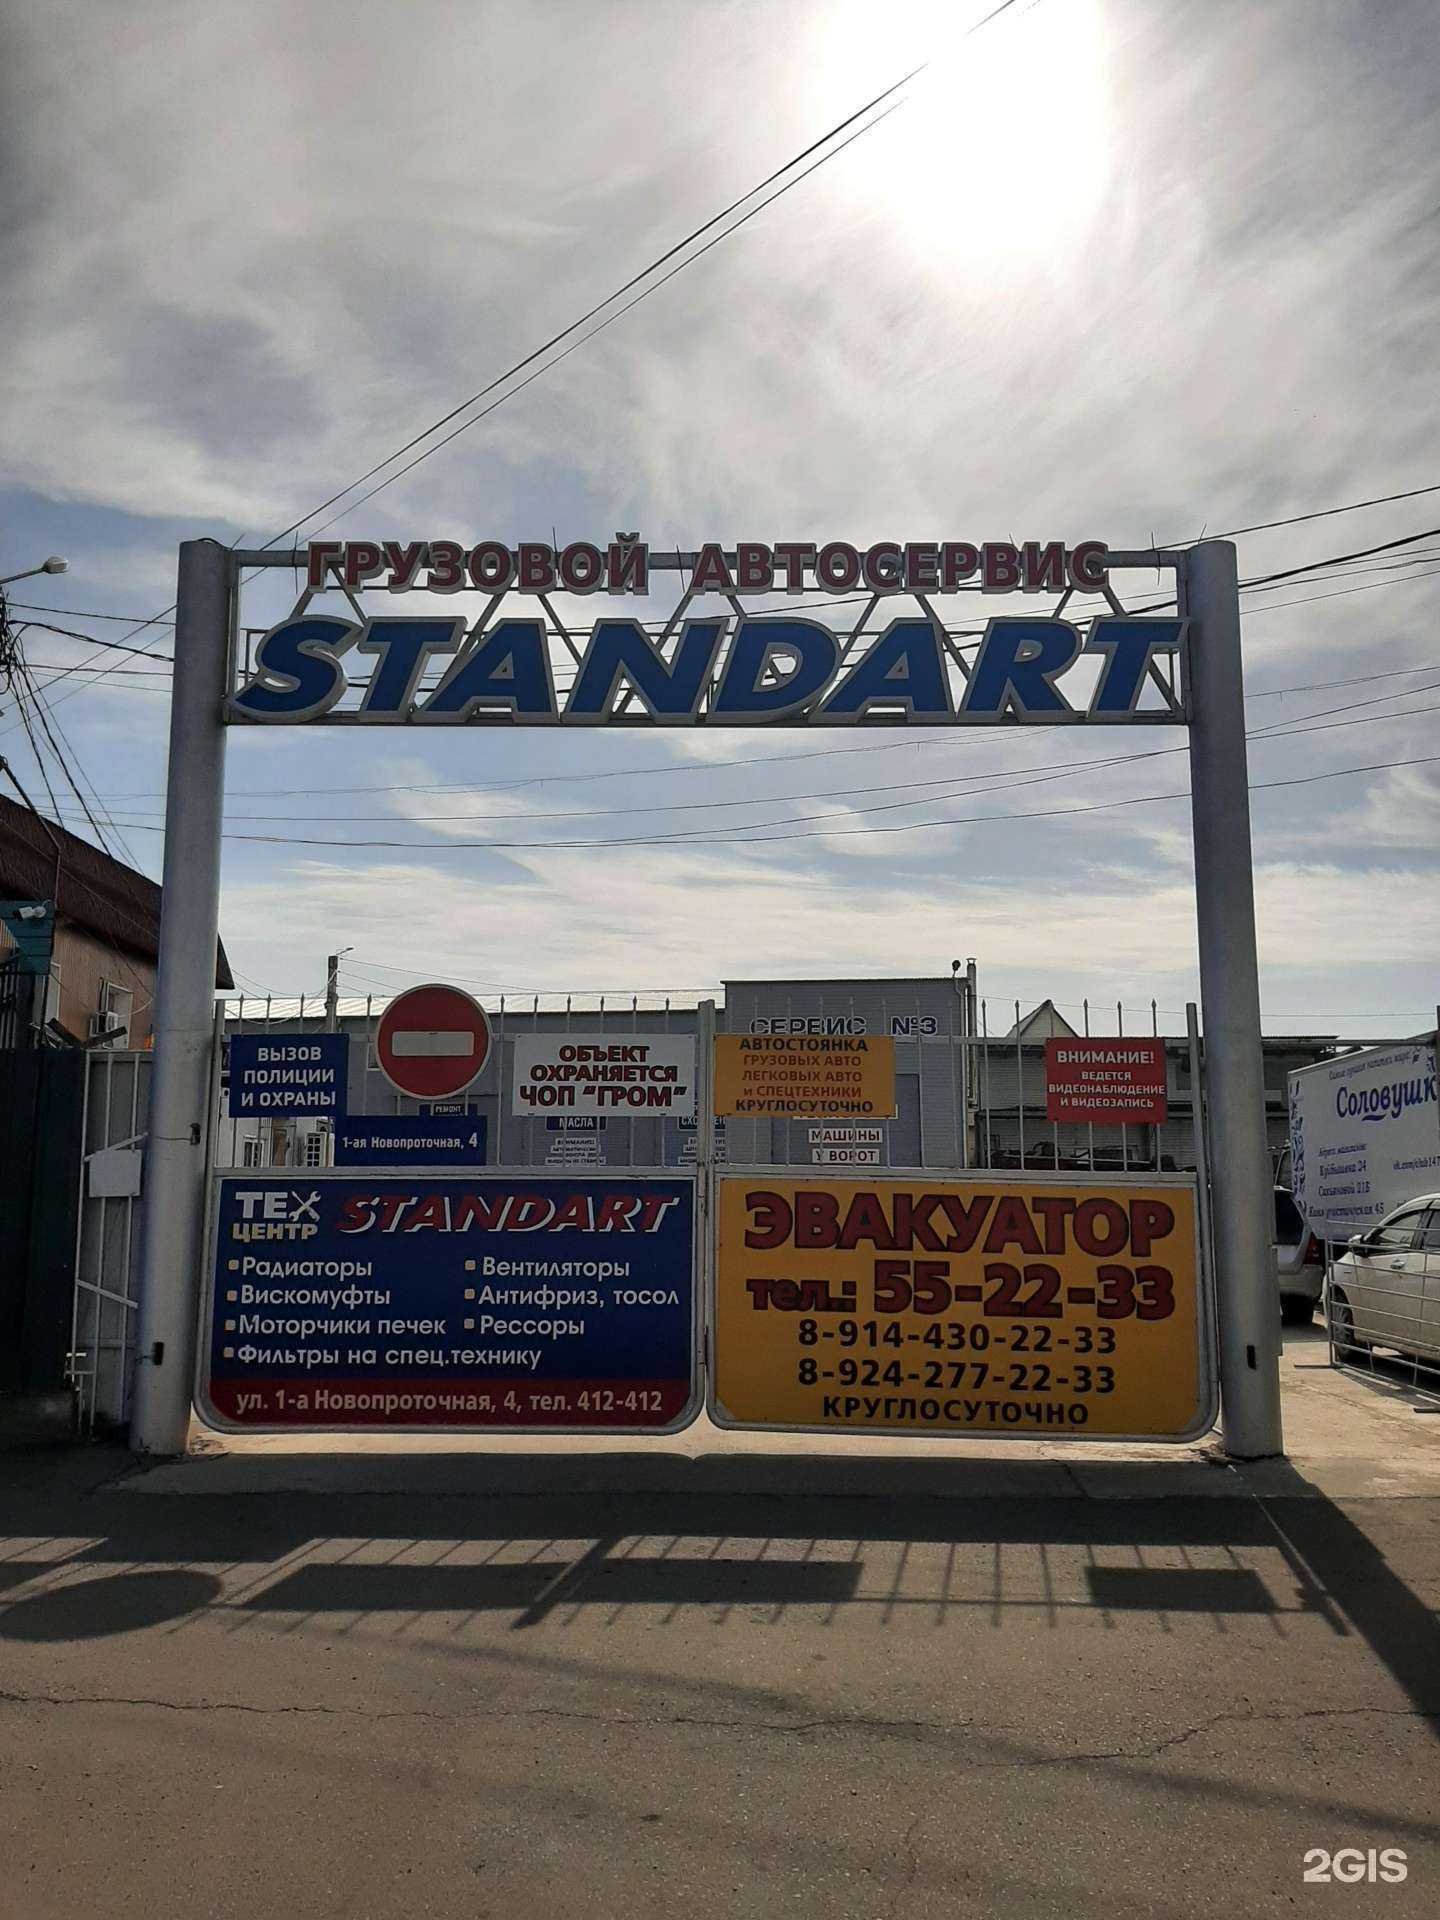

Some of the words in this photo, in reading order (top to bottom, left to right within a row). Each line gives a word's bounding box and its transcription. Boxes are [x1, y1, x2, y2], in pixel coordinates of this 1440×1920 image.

[307, 532, 649, 596] ГРУЗОВОЙ
[691, 541, 1109, 595] АВТОСЕРВИС
[226, 614, 1190, 724] STANDART
[750, 1016, 867, 1036] СЕРВИС
[890, 1015, 938, 1036] №3
[257, 1047, 322, 1062] ВЫЗОВ
[559, 1045, 650, 1062] ОБЪЕКТ
[739, 1038, 868, 1052] АВТОСТОЯНКА
[743, 1054, 820, 1067] ГРУЗОВЫХ
[824, 1055, 861, 1067] АВТО
[1057, 1050, 1155, 1064] ВНИМАНИЕ!
[244, 1068, 334, 1086] ПОЛИЦИИ
[530, 1065, 678, 1082] ОХРАНЯЕТСЯ
[742, 1070, 821, 1082] ЛЕГКОВЫХ
[825, 1071, 862, 1083] АВТО
[1081, 1071, 1131, 1081] ВЕДЕТСЯ
[241, 1092, 253, 1107] И
[259, 1091, 336, 1106] ОХРАНЫ
[519, 1086, 574, 1107] ЧОП
[756, 1085, 861, 1099] СПЕЦТЕХНИКИ
[1049, 1084, 1165, 1095] ВИДЕОНАБЛЮДЕНИЕ
[736, 1099, 873, 1113] КРУГЛОСУТОЧНО
[1061, 1098, 1068, 1106] И
[1072, 1098, 1154, 1108] ВИДЕОЗАПИСЬ
[342, 1136, 367, 1148] 1-ая
[371, 1136, 465, 1150] Новопроточная,
[468, 1132, 478, 1147] 4
[811, 1130, 879, 1141] МАШИНЫ
[336, 1196, 680, 1233] STANDART
[744, 1191, 1175, 1257] ЭВАКУАТОР
[232, 1223, 319, 1241] ЦЕНТР
[242, 1257, 372, 1280] Радиаторы
[482, 1257, 630, 1280] Вентиляторы
[241, 1285, 391, 1308] Вискомуфты
[478, 1285, 604, 1309] Антифриз,
[613, 1289, 679, 1306] тосол
[746, 1277, 857, 1313] тел.:
[874, 1260, 1175, 1320] 55-22-33
[238, 1316, 370, 1339] Моторчики
[377, 1318, 446, 1335] печек
[480, 1316, 585, 1339] Рессоры
[798, 1319, 1116, 1354] 8-914-430-22-33
[238, 1345, 339, 1369] Фильтры
[347, 1348, 376, 1365] на
[385, 1348, 541, 1370] спец.технику
[798, 1358, 1115, 1394] 8-924-277-22-33
[236, 1391, 268, 1415] ул.
[275, 1389, 308, 1410] 1-а
[314, 1390, 497, 1415] Новопроточная,
[503, 1390, 522, 1413] 4,
[529, 1393, 573, 1411] тел.
[577, 1390, 662, 1412] 412-412
[823, 1395, 1088, 1425] КРУГЛОСУТОЧНО
